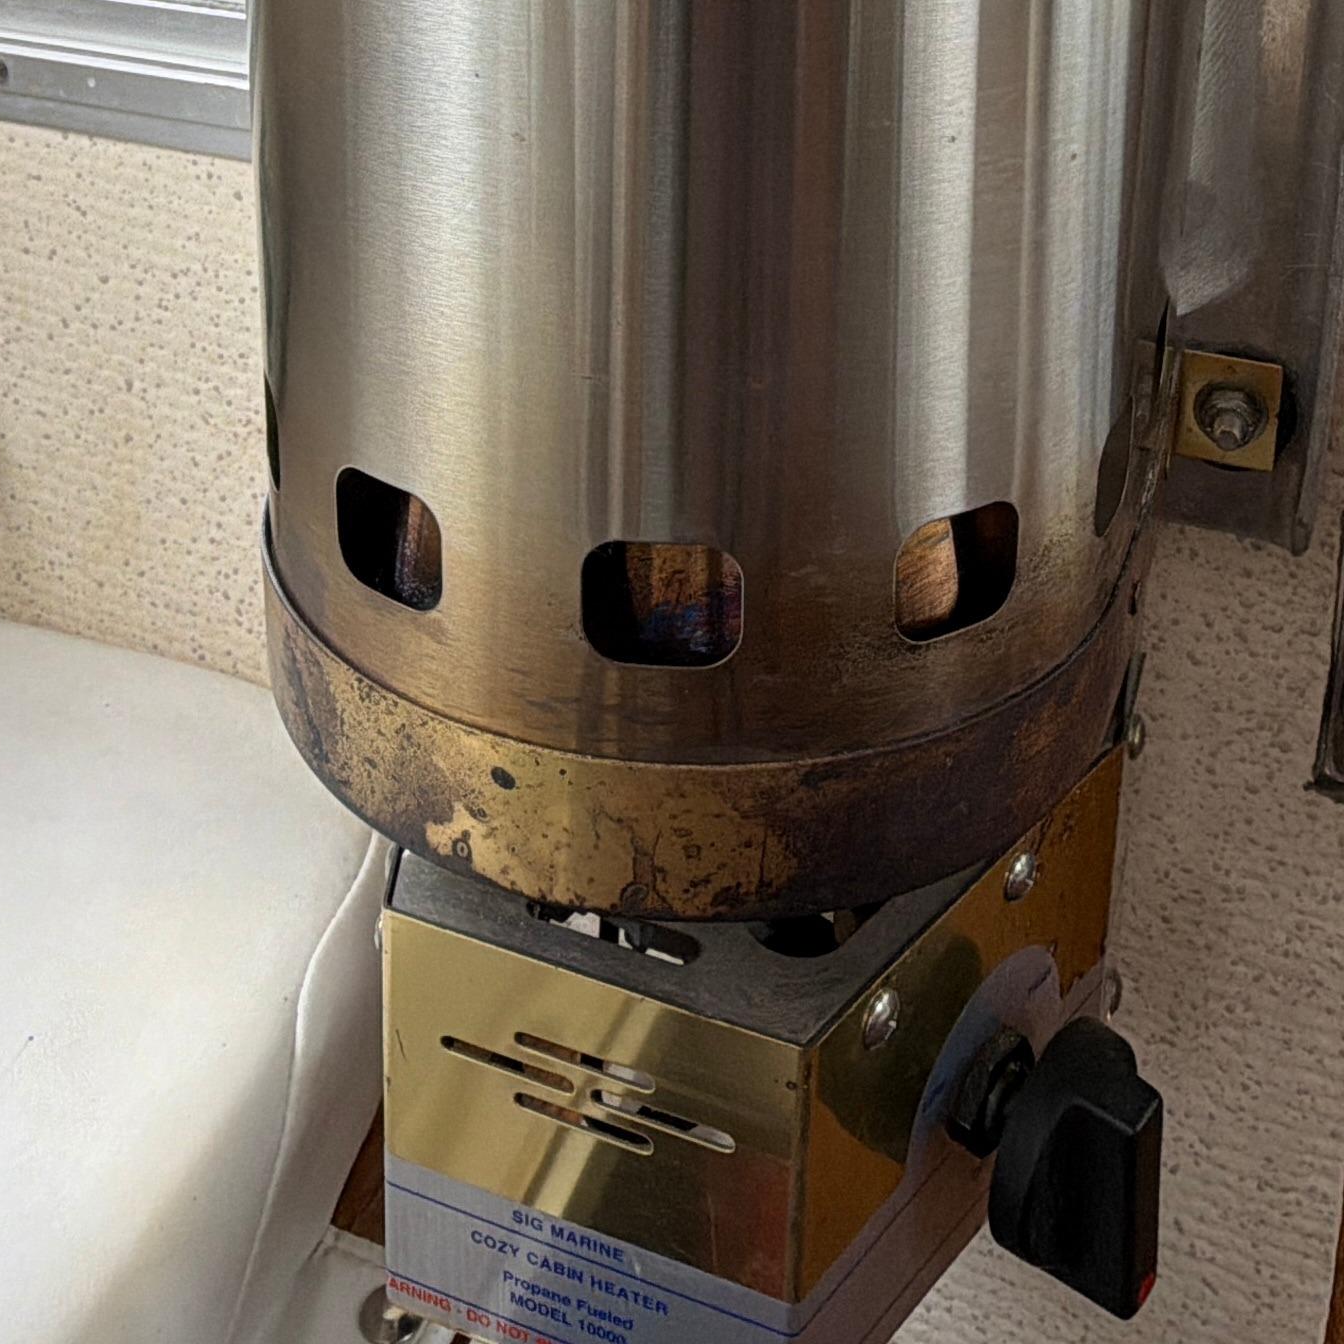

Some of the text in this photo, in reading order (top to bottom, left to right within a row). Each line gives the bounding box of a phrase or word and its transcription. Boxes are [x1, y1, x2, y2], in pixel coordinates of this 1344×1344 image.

[511, 1209, 625, 1263] SIG MARINE
[470, 1230, 670, 1316] COZY CABIN HEATER
[502, 1270, 635, 1331] Propane Fueled
[388, 1277, 530, 1343] ARNING DO NOT
[509, 1292, 573, 1327] MODEL
